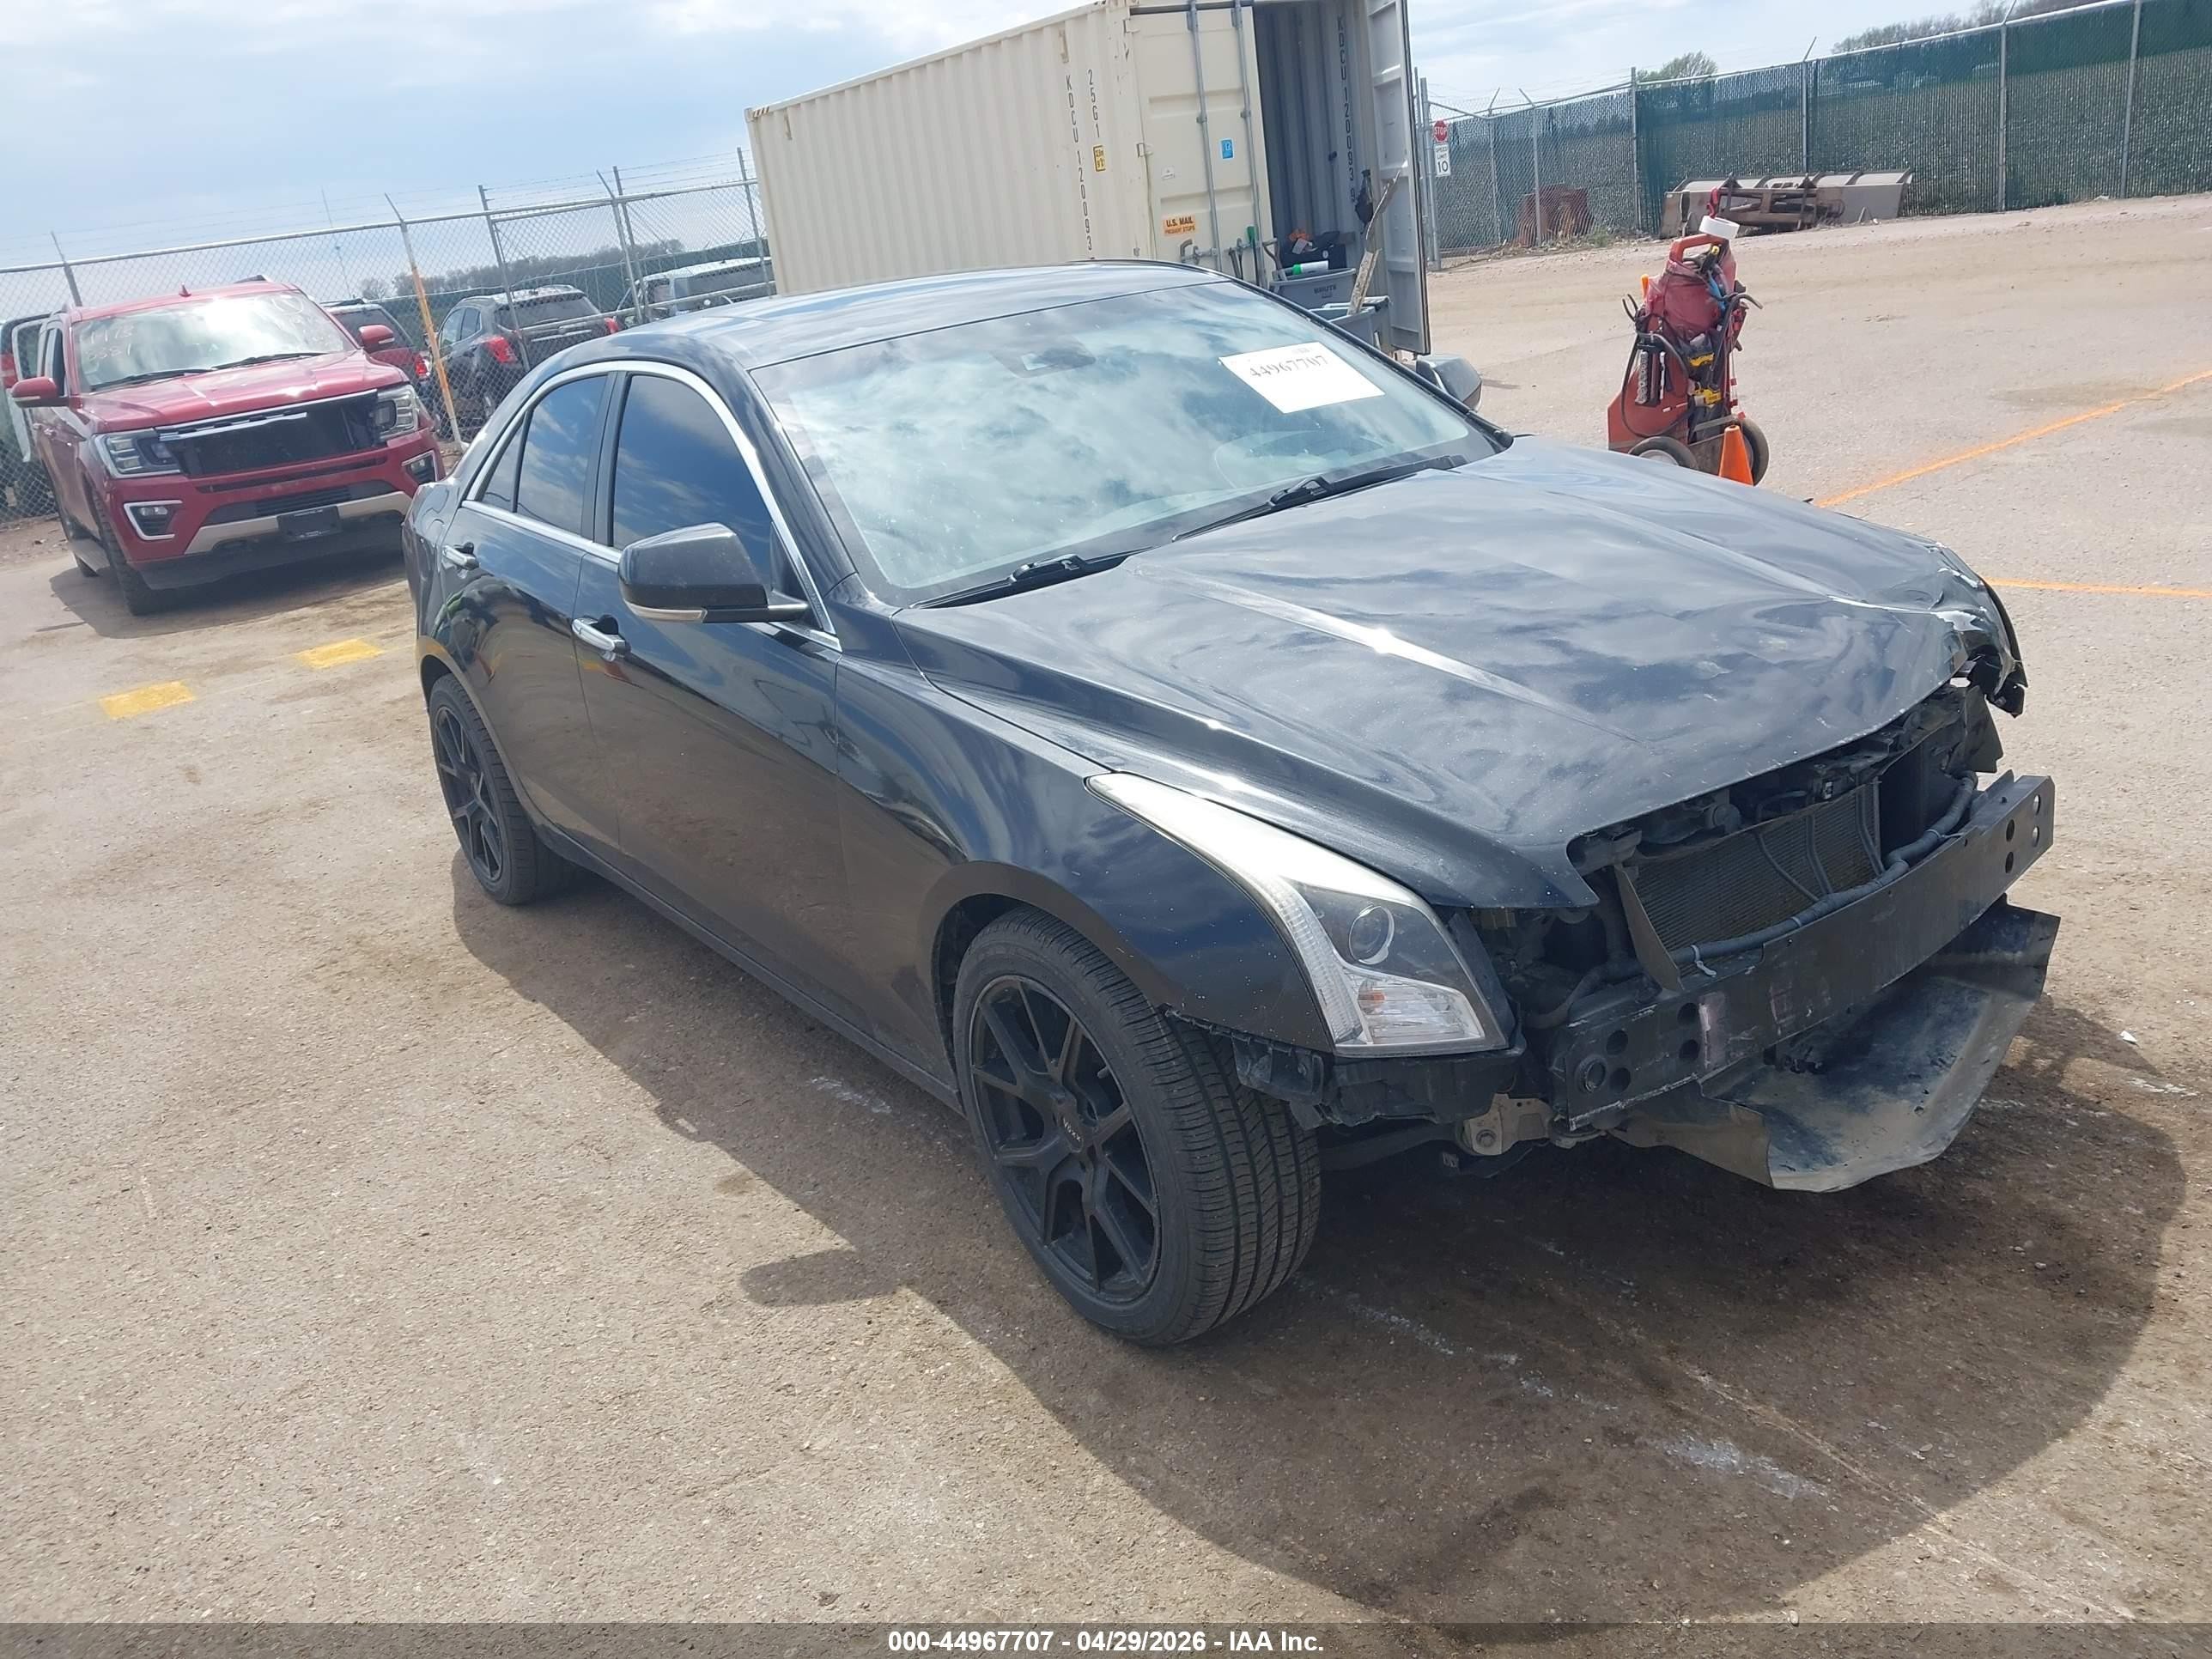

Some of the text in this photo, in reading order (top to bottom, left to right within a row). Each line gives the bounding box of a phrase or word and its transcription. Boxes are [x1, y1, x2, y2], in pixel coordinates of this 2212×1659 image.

[1087, 69, 1100, 138] 25G1
[1345, 87, 1354, 181] 120093
[1066, 74, 1092, 251] KDCU 120093
[1437, 160, 1449, 173] 10
[1166, 216, 1194, 228] U.S. MAIL
[1249, 355, 1328, 378] 44967707
